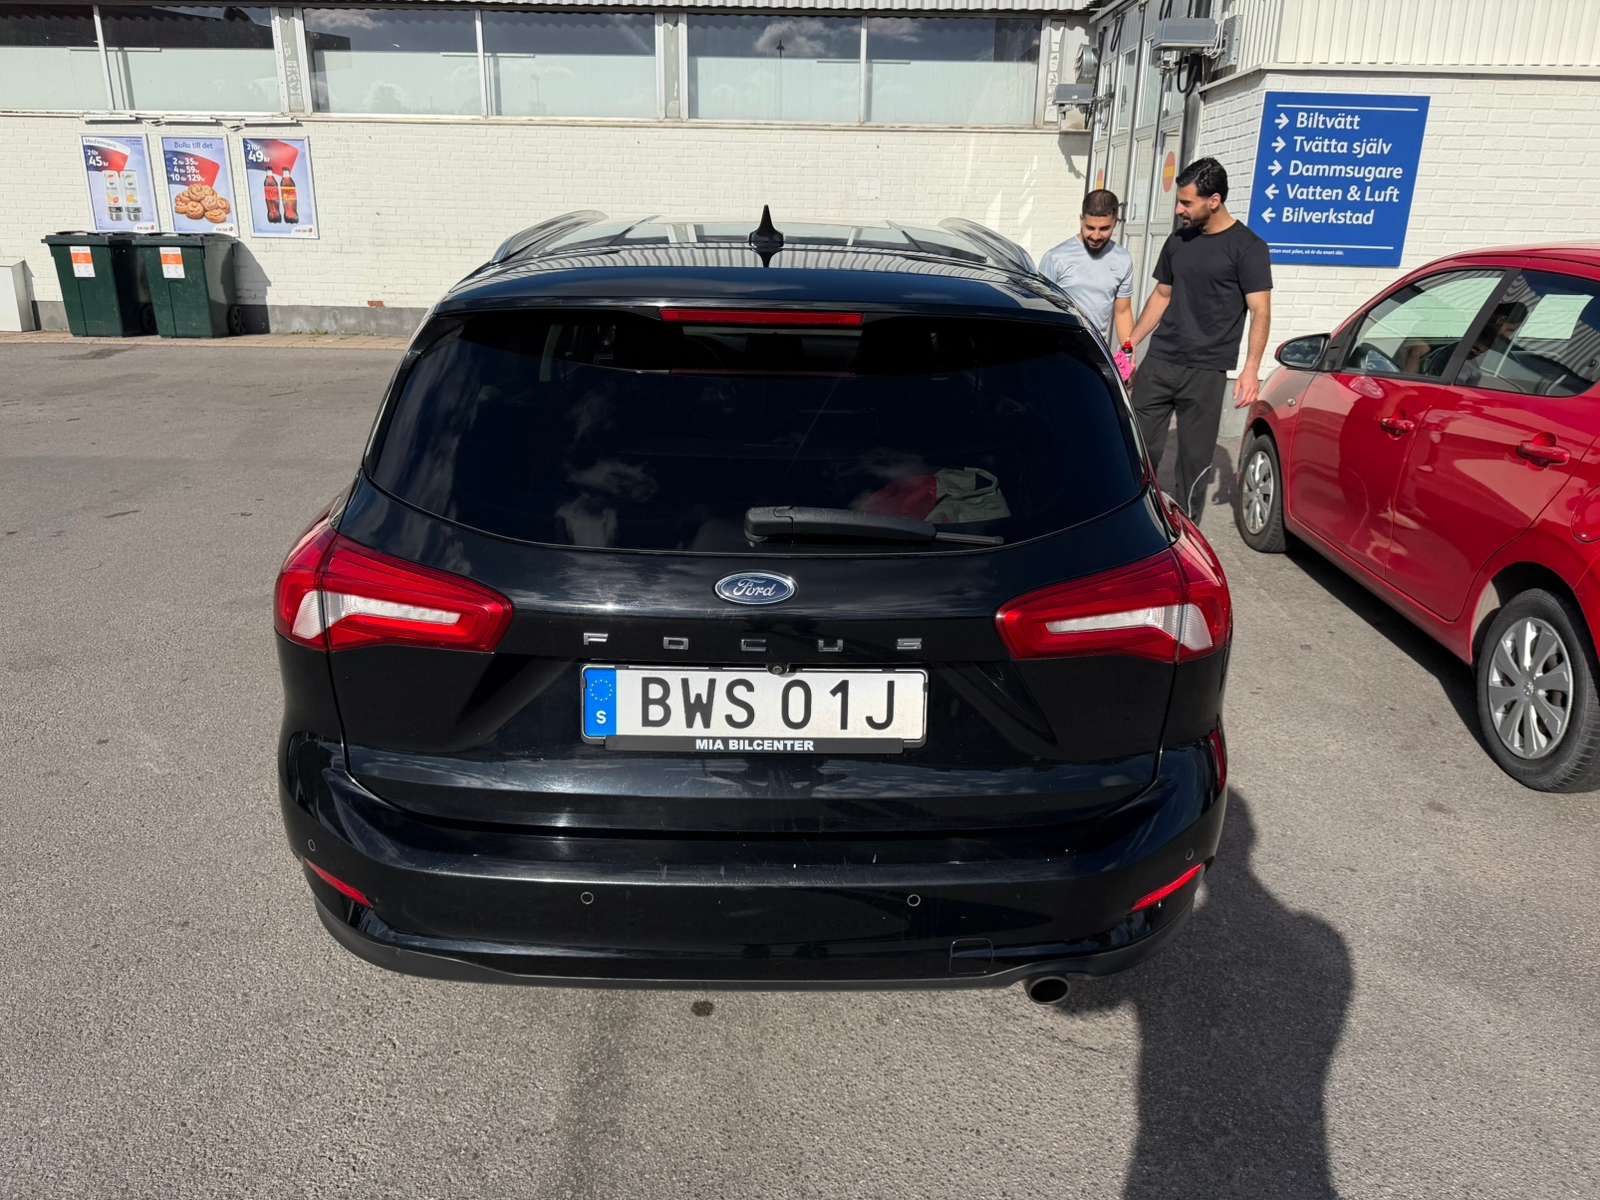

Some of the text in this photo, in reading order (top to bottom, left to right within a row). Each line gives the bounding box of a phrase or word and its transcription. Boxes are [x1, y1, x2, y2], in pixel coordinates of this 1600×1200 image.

[1296, 112, 1360, 130] Biltvätt
[1293, 136, 1392, 158] Tvätta själv
[1289, 160, 1403, 182] Dammsugare
[1286, 183, 1400, 203] Vatten & Luft
[1282, 207, 1375, 225] Bilverkstad
[733, 578, 776, 597] Ford
[583, 632, 923, 653] FOCUS
[641, 676, 895, 731] BWS 01J
[596, 710, 607, 724] S
[695, 738, 815, 752] MIA BILCENTER
